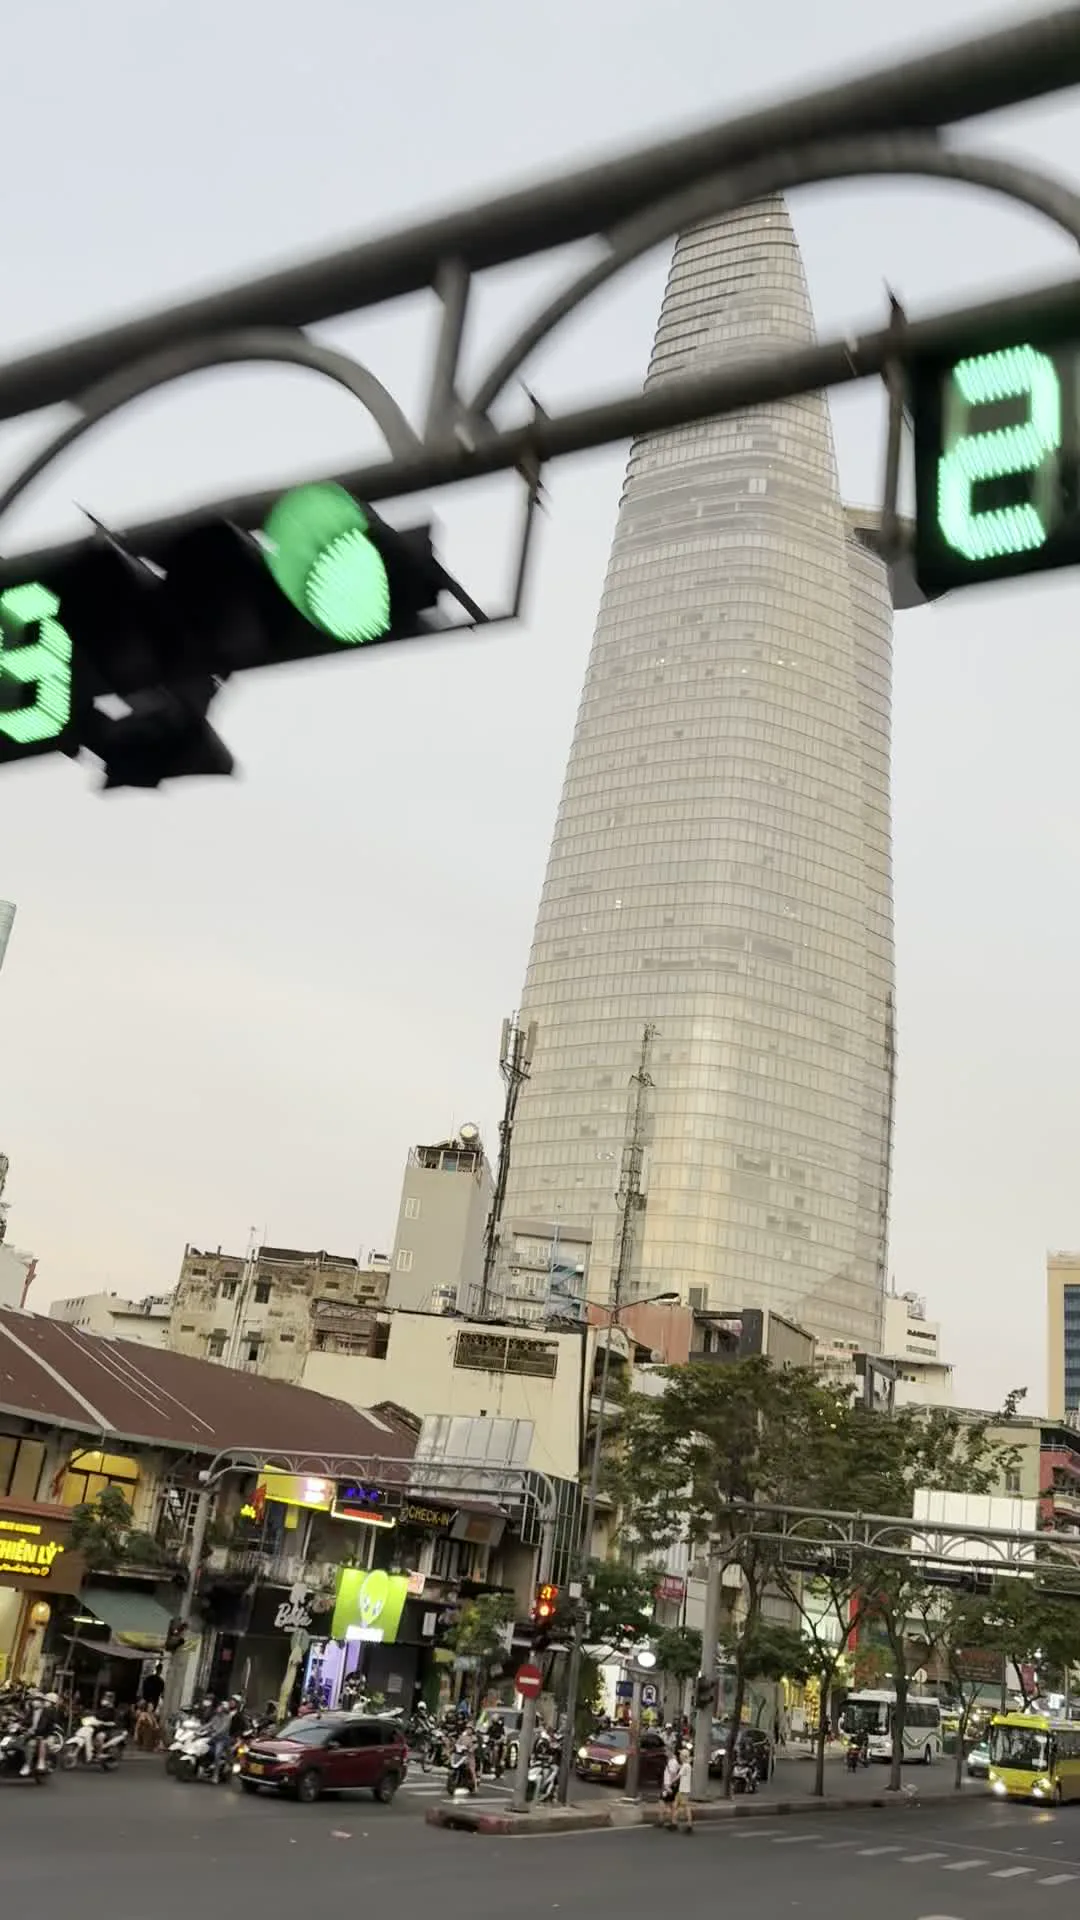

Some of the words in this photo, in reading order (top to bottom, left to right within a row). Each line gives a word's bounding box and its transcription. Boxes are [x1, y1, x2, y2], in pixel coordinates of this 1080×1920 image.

[937, 344, 1061, 561] 2
[409, 1505, 449, 1527] CHECK-IN
[0, 1538, 37, 1563] HIÊN
